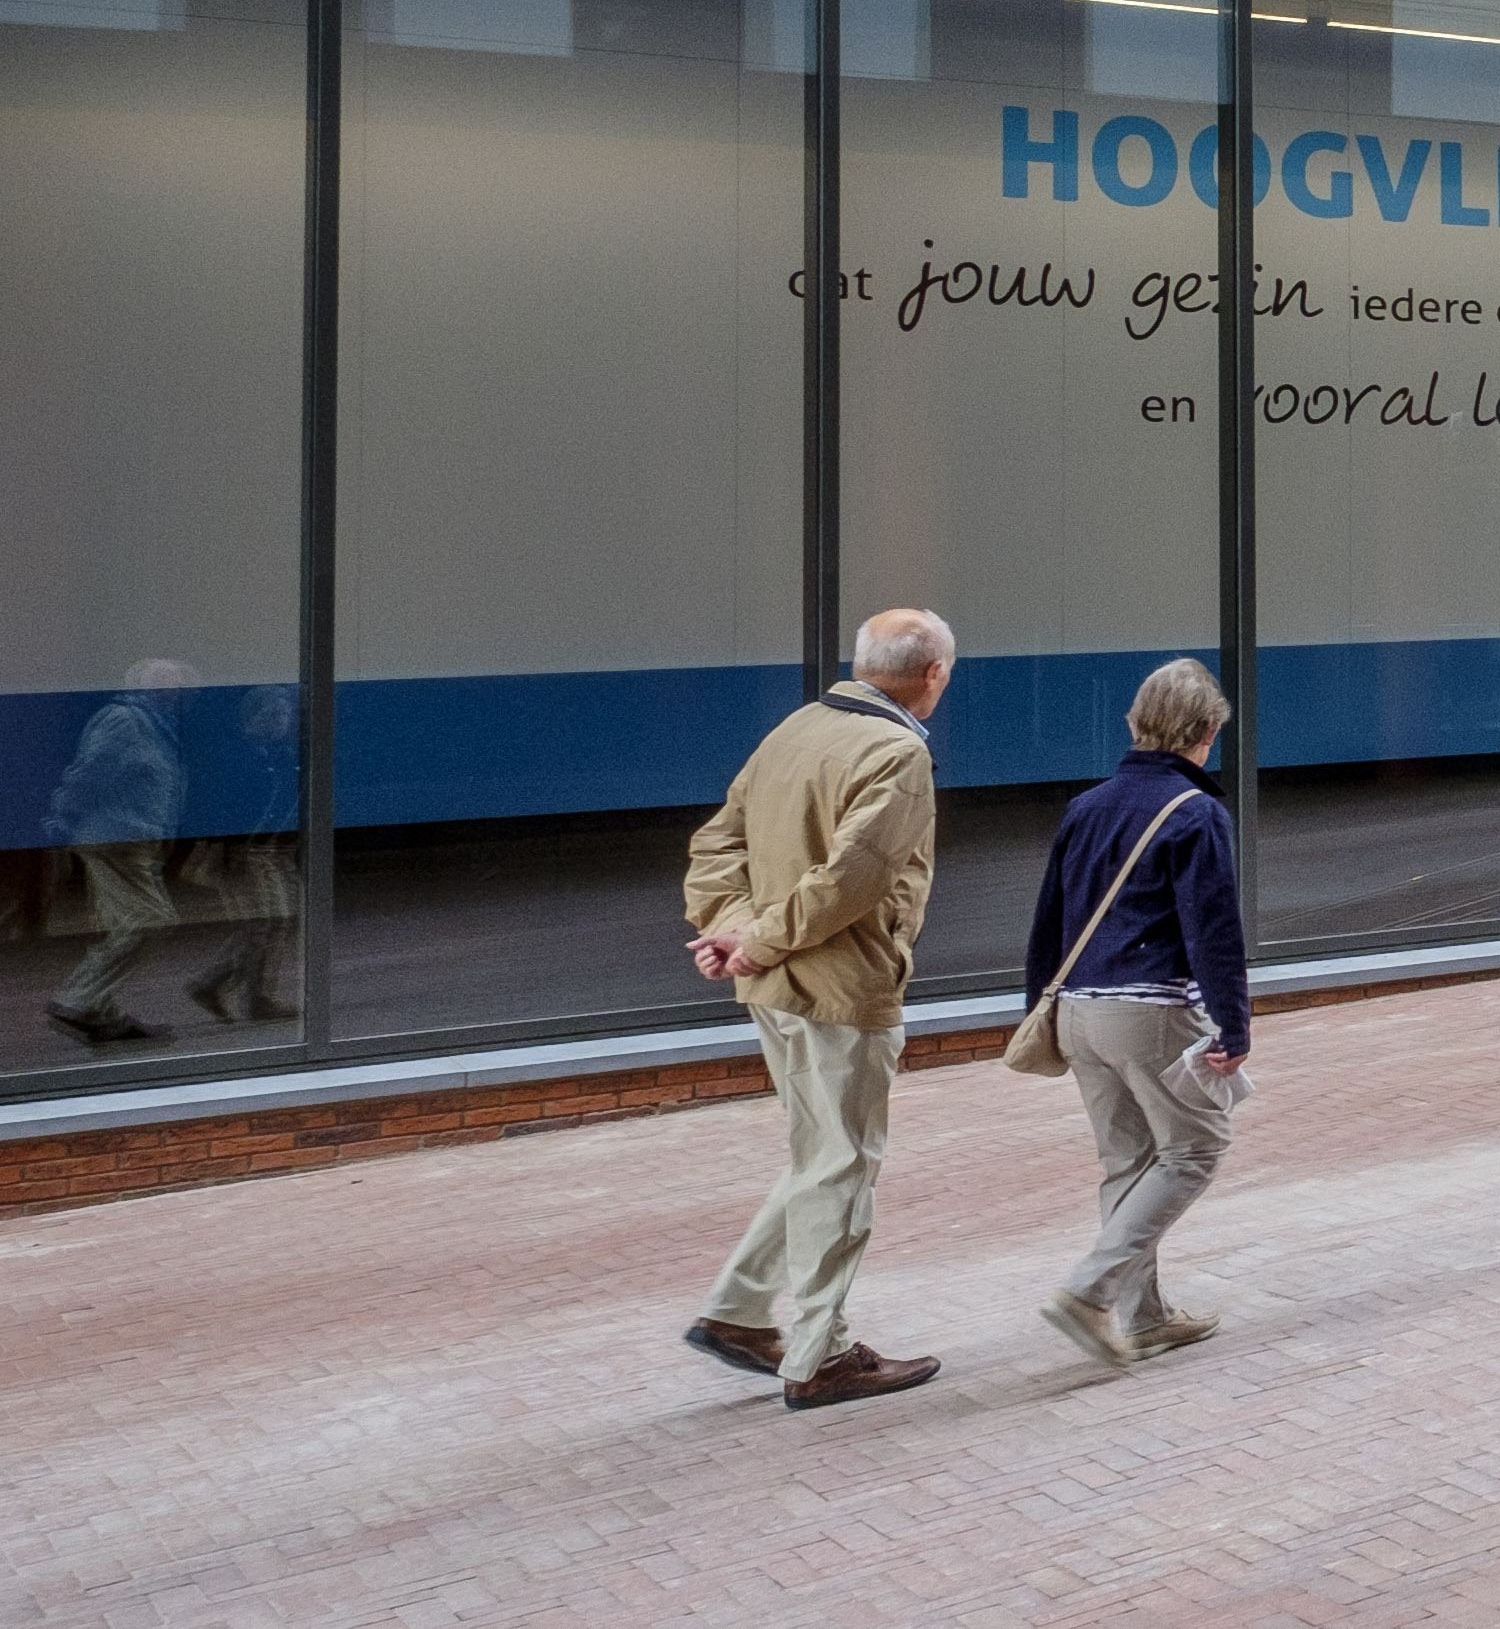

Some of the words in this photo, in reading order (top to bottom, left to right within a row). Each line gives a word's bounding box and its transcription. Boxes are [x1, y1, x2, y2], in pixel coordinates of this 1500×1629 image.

[898, 239, 1095, 332] jouw
[1350, 285, 1483, 324] iedere
[1141, 395, 1196, 423] en
[1253, 370, 1449, 426] ooral
